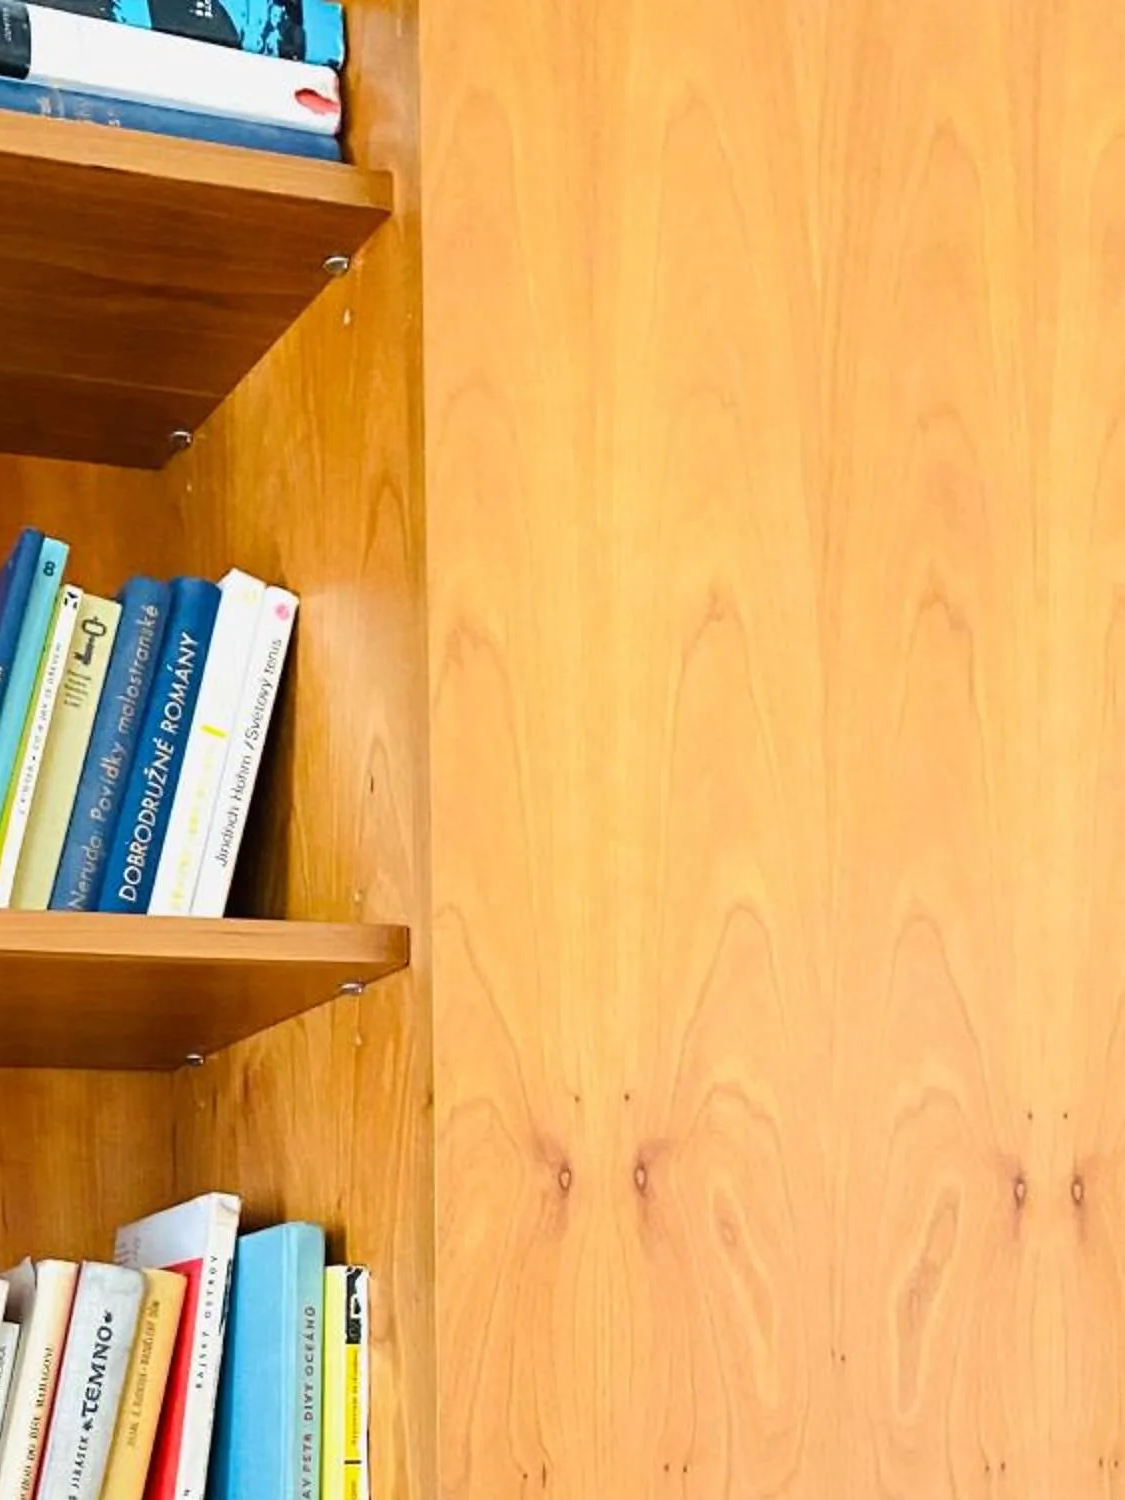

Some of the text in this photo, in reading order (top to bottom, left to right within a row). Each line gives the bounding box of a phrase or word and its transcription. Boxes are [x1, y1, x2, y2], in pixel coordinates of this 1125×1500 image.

[117, 736, 172, 903] DOBRODRUŽNÉ
[158, 628, 201, 735] ROMÁNY
[77, 1324, 117, 1420] TEMNO
[302, 1305, 317, 1376] OCEÁNŮ
[303, 1381, 315, 1420] DIVY
[66, 1433, 92, 1489] JIRÁSEK
[301, 1431, 314, 1472] PETR
